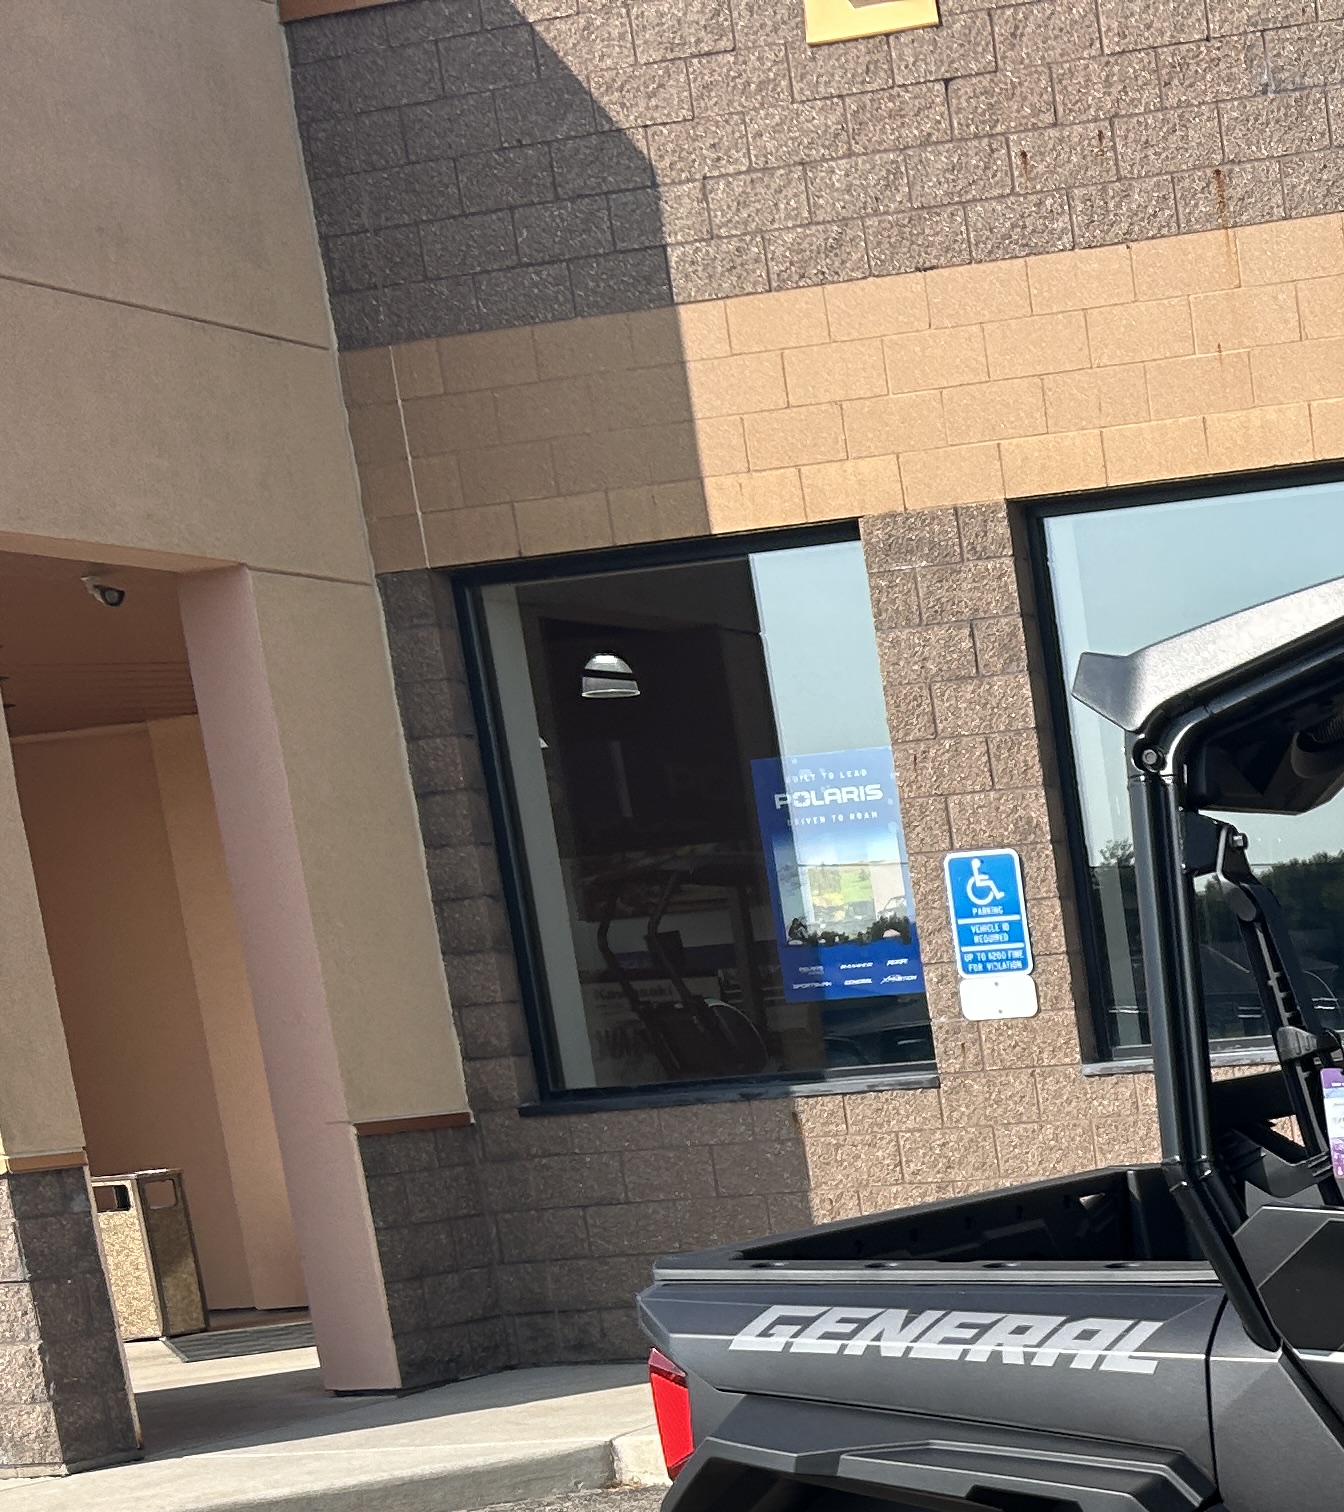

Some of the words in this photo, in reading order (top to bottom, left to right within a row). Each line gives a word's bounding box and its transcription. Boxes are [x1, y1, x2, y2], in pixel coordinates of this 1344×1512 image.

[774, 784, 883, 810] POLARIS
[972, 906, 1003, 916] PARKING
[970, 923, 1000, 934] VEHICLE
[728, 1304, 1164, 1375] GENERAL
